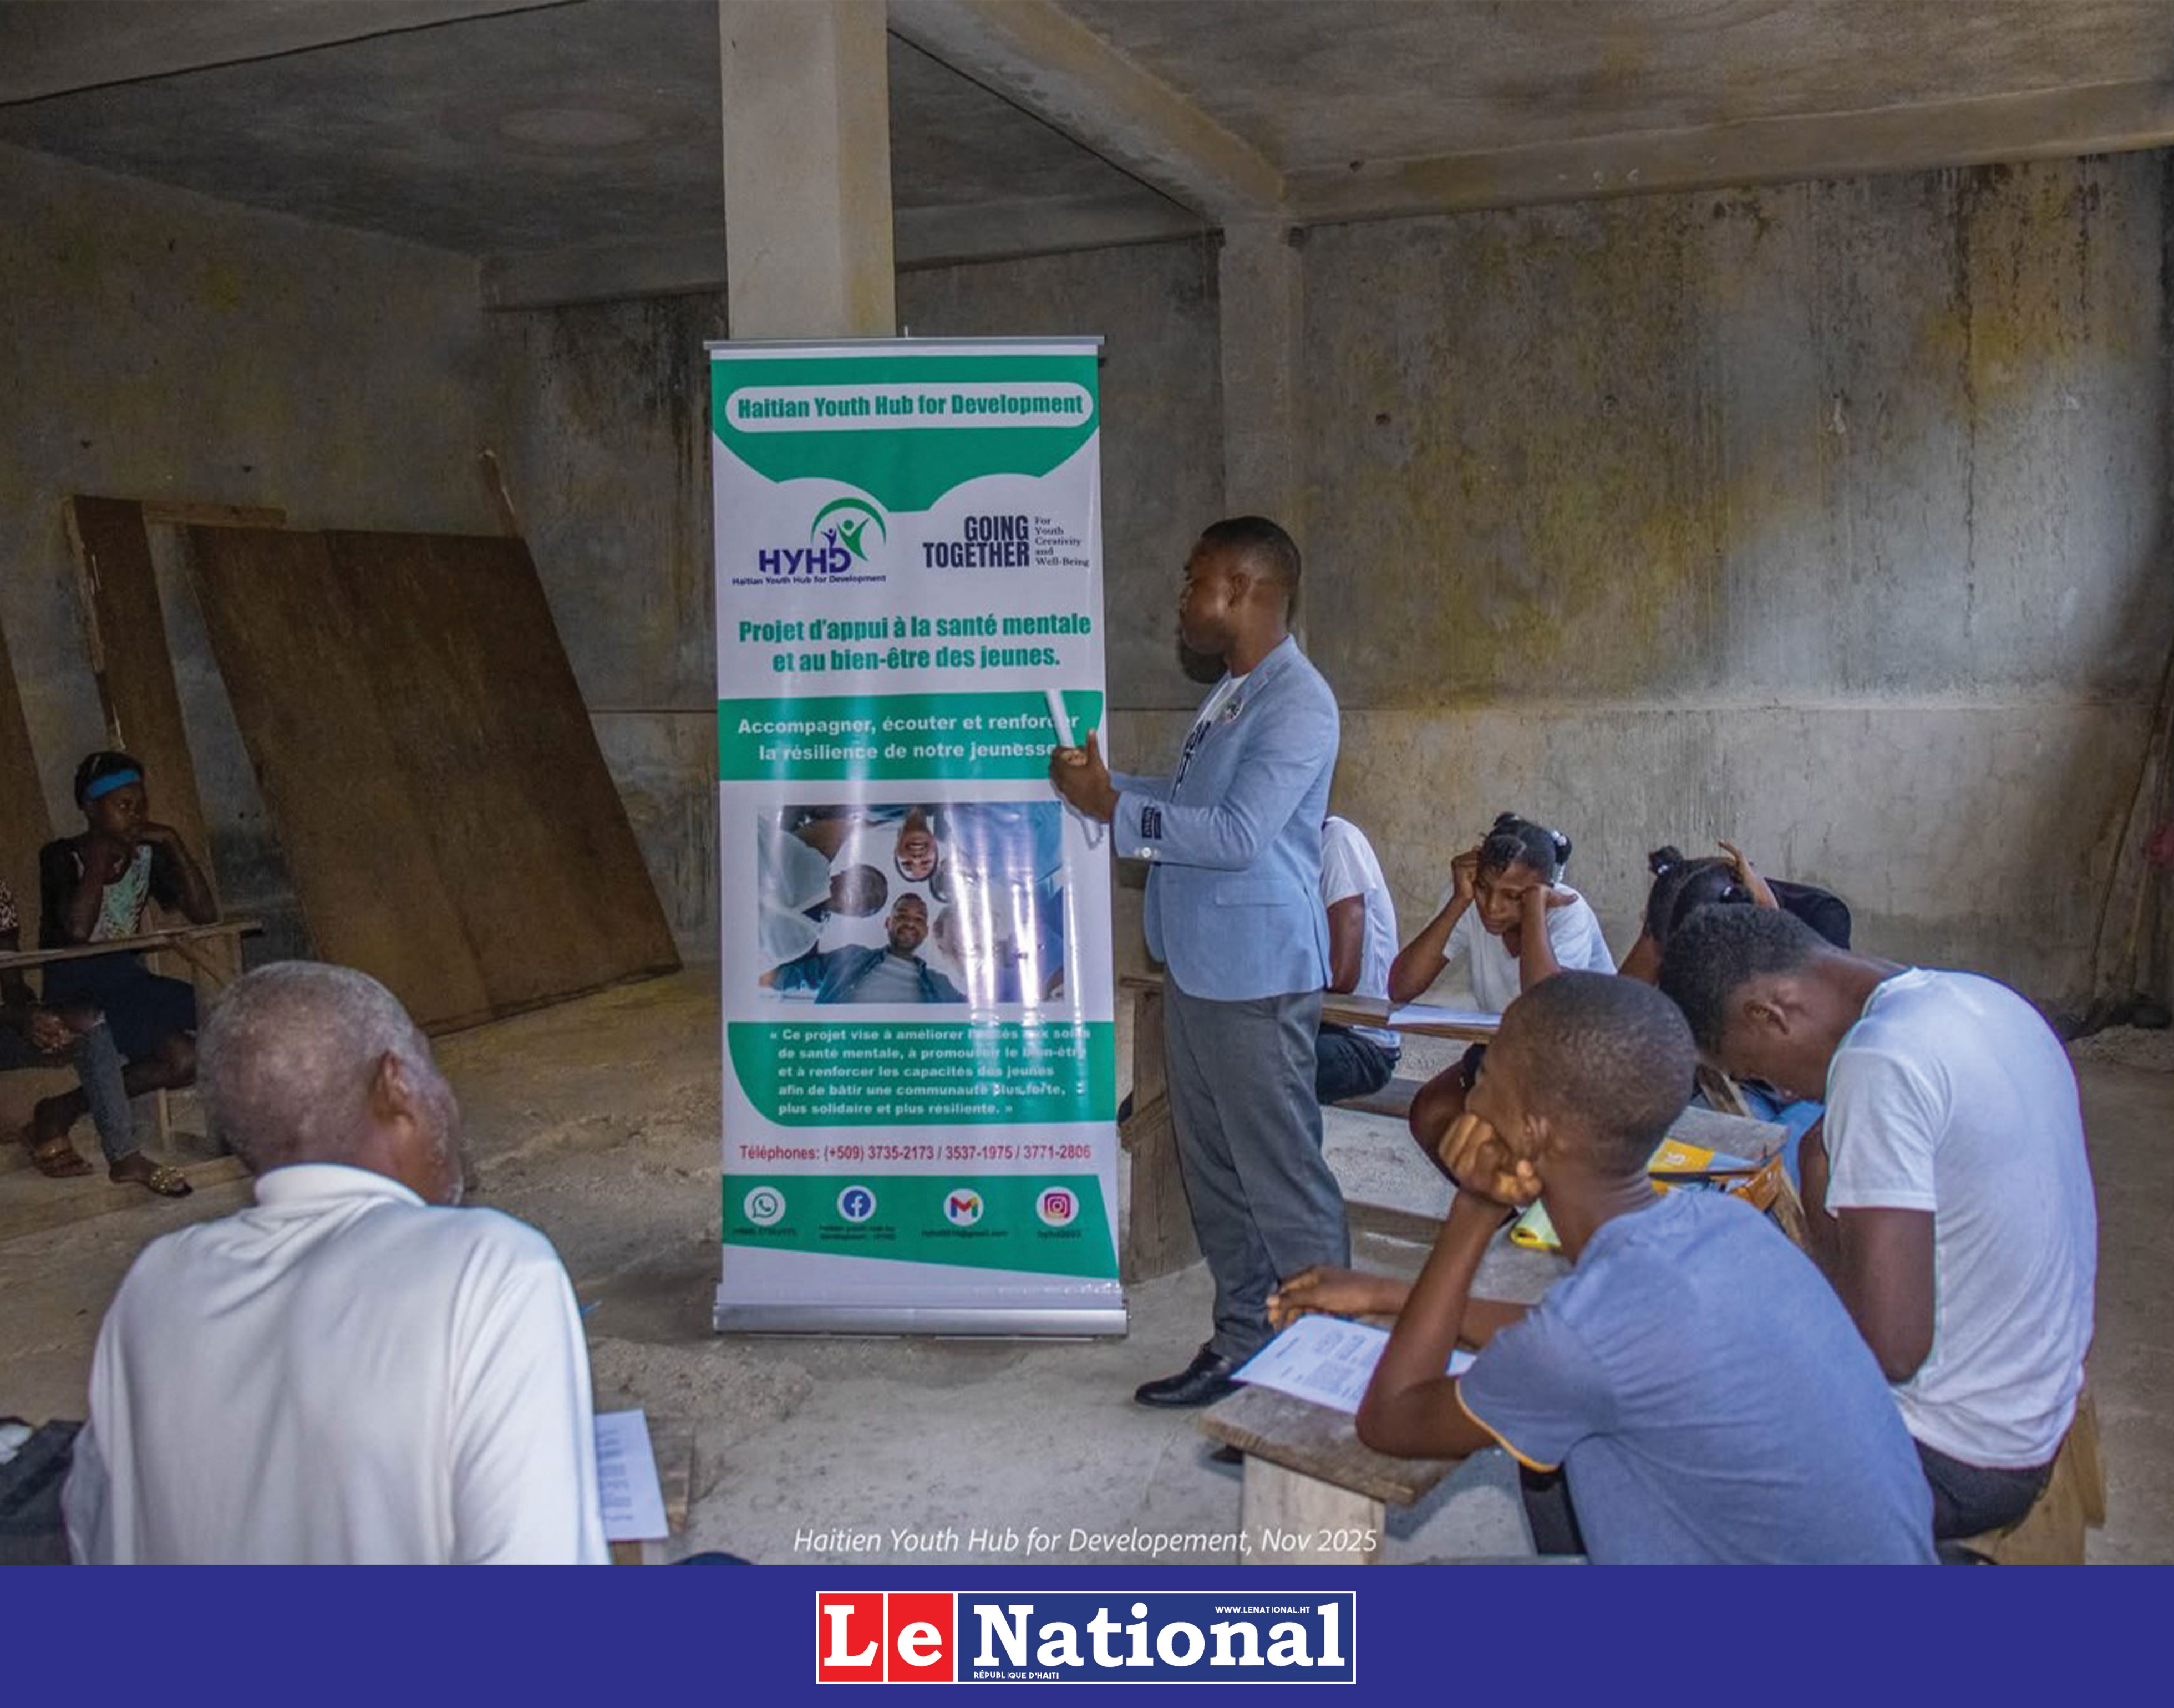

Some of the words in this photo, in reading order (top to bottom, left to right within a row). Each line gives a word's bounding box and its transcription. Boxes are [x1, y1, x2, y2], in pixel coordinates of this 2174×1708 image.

[737, 397, 810, 419] Haitian
[814, 396, 871, 418] Youth
[875, 395, 914, 416] Hub
[918, 394, 947, 415] for
[951, 394, 1084, 417] Development
[964, 515, 1029, 542] GOING
[1035, 526, 1064, 535] Youth
[1035, 537, 1082, 547] Creativity
[923, 542, 1030, 568] TOGETHER
[1035, 547, 1054, 555] and
[758, 547, 852, 576] HYHD
[1035, 556, 1090, 568] Well-Being
[732, 577, 764, 586] Haitian
[765, 576, 791, 585] Youth
[793, 576, 811, 584] Hub
[814, 575, 827, 583] for
[829, 574, 886, 583] Development
[739, 619, 804, 644] Projet
[809, 617, 889, 643] d'appui
[893, 616, 907, 638] à
[911, 614, 932, 637] la
[936, 613, 998, 637] santé
[1002, 612, 1091, 636] mentale
[773, 652, 795, 673] et
[799, 654, 826, 672] au
[830, 647, 927, 670] bien-être
[931, 645, 976, 669] des
[980, 643, 1061, 670] jeunes.
[738, 716, 877, 738] Accompagner,
[882, 715, 958, 731] écouter
[963, 715, 983, 730] et
[759, 745, 779, 760] la
[783, 744, 878, 760] résilience
[885, 743, 907, 759] de
[913, 744, 964, 758] notre
[783, 1029, 800, 1040] Ce
[805, 1029, 846, 1043] projet
[851, 1029, 880, 1040] vise
[896, 1028, 963, 1040] améliorer
[778, 1048, 795, 1059] de
[799, 1047, 839, 1059] santé
[842, 1047, 903, 1060] mentale,
[1005, 1046, 1018, 1058] le
[778, 1067, 793, 1077] et
[809, 1066, 875, 1077] renforcer
[878, 1066, 900, 1077] les
[903, 1065, 973, 1079] capacités
[1007, 1065, 1054, 1079] jeunes
[779, 1085, 804, 1095] afin
[808, 1085, 825, 1095] de
[867, 1085, 891, 1095] une
[896, 1083, 988, 1096] communauté
[778, 1103, 807, 1116] plus
[811, 1102, 872, 1115] solidaire
[877, 1104, 891, 1114] et
[896, 1102, 924, 1116] plus
[929, 1101, 1000, 1115] résiliente.
[740, 1145, 820, 1162] Téléphones:
[824, 1146, 864, 1162] (+509)
[868, 1146, 934, 1161] 3735-2173
[938, 1146, 942, 1160] /
[946, 1146, 1012, 1160] 3537-1975
[1015, 1146, 1020, 1160] /
[1023, 1146, 1091, 1160] 3771-2806
